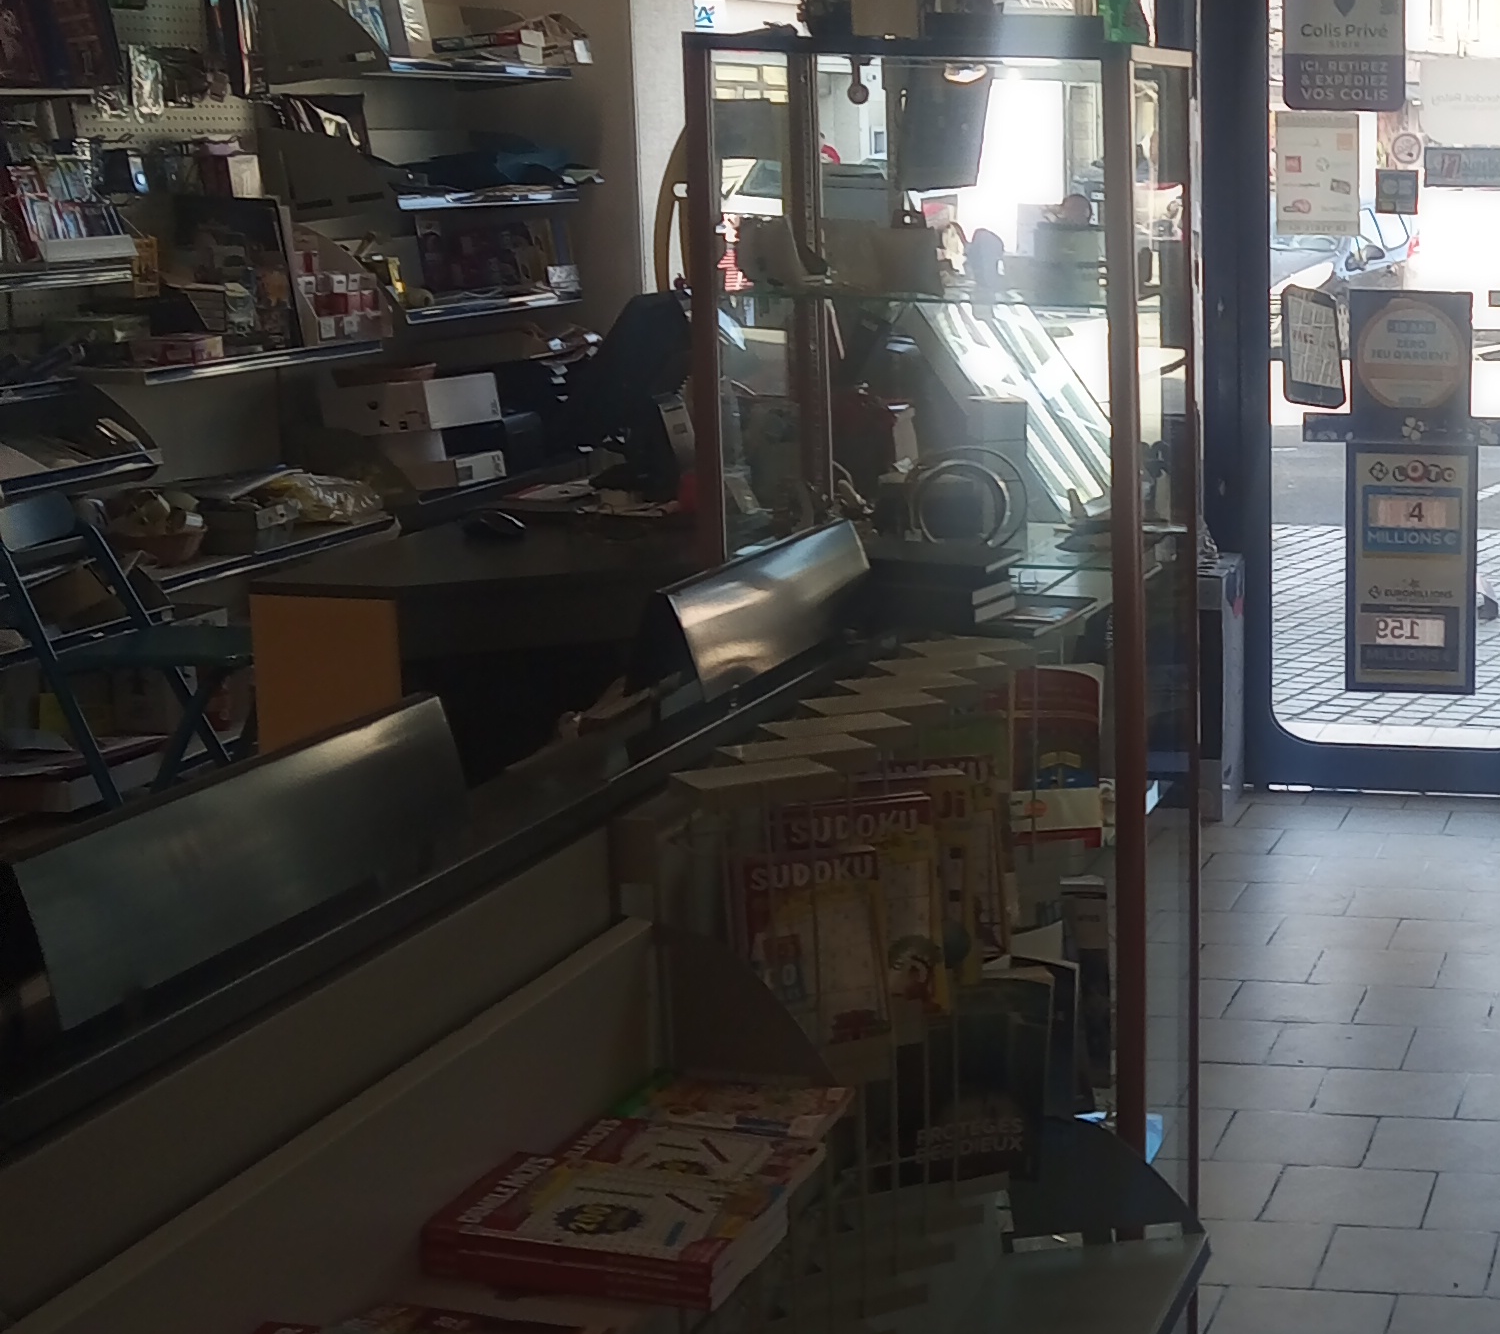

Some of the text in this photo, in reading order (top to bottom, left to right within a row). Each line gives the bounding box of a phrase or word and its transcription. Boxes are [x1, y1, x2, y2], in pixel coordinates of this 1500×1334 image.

[1299, 23, 1389, 38] Colis Privé
[1328, 60, 1389, 73] RETIREZ
[1300, 88, 1389, 101] VOS COLIS
[1392, 459, 1457, 484] LOTO
[1408, 501, 1425, 523] 4
[1366, 529, 1442, 545] MILLIONS
[750, 852, 874, 892] SUDOKU
[959, 1136, 1024, 1156] DIEUX
